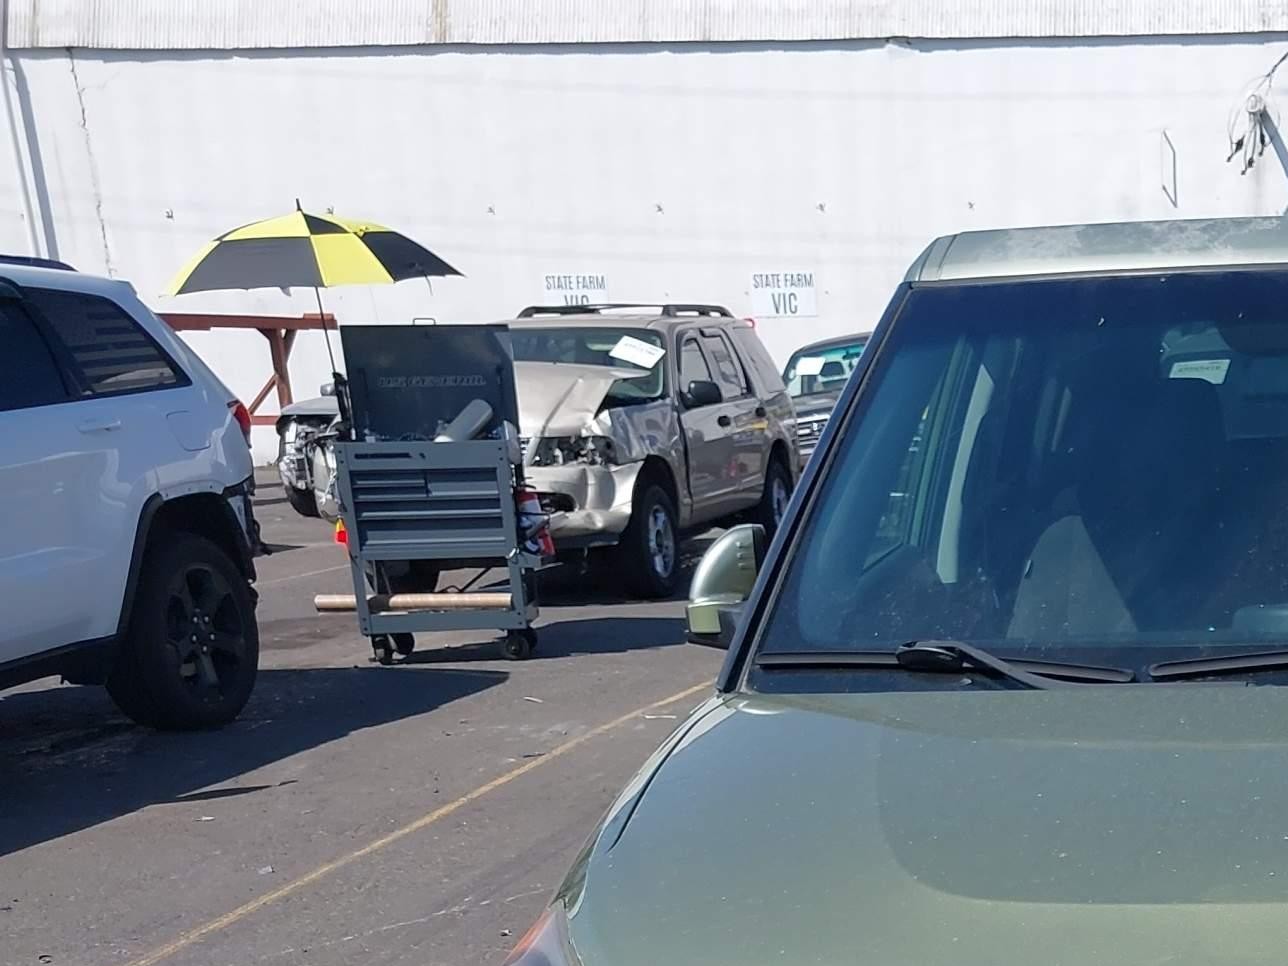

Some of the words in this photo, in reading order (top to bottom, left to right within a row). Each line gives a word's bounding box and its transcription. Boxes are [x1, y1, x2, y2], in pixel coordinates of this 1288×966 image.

[545, 275, 574, 290] STATE
[576, 275, 606, 290] FARM
[753, 273, 781, 289] STATE
[785, 273, 814, 288] FARM
[772, 292, 798, 314] VIC
